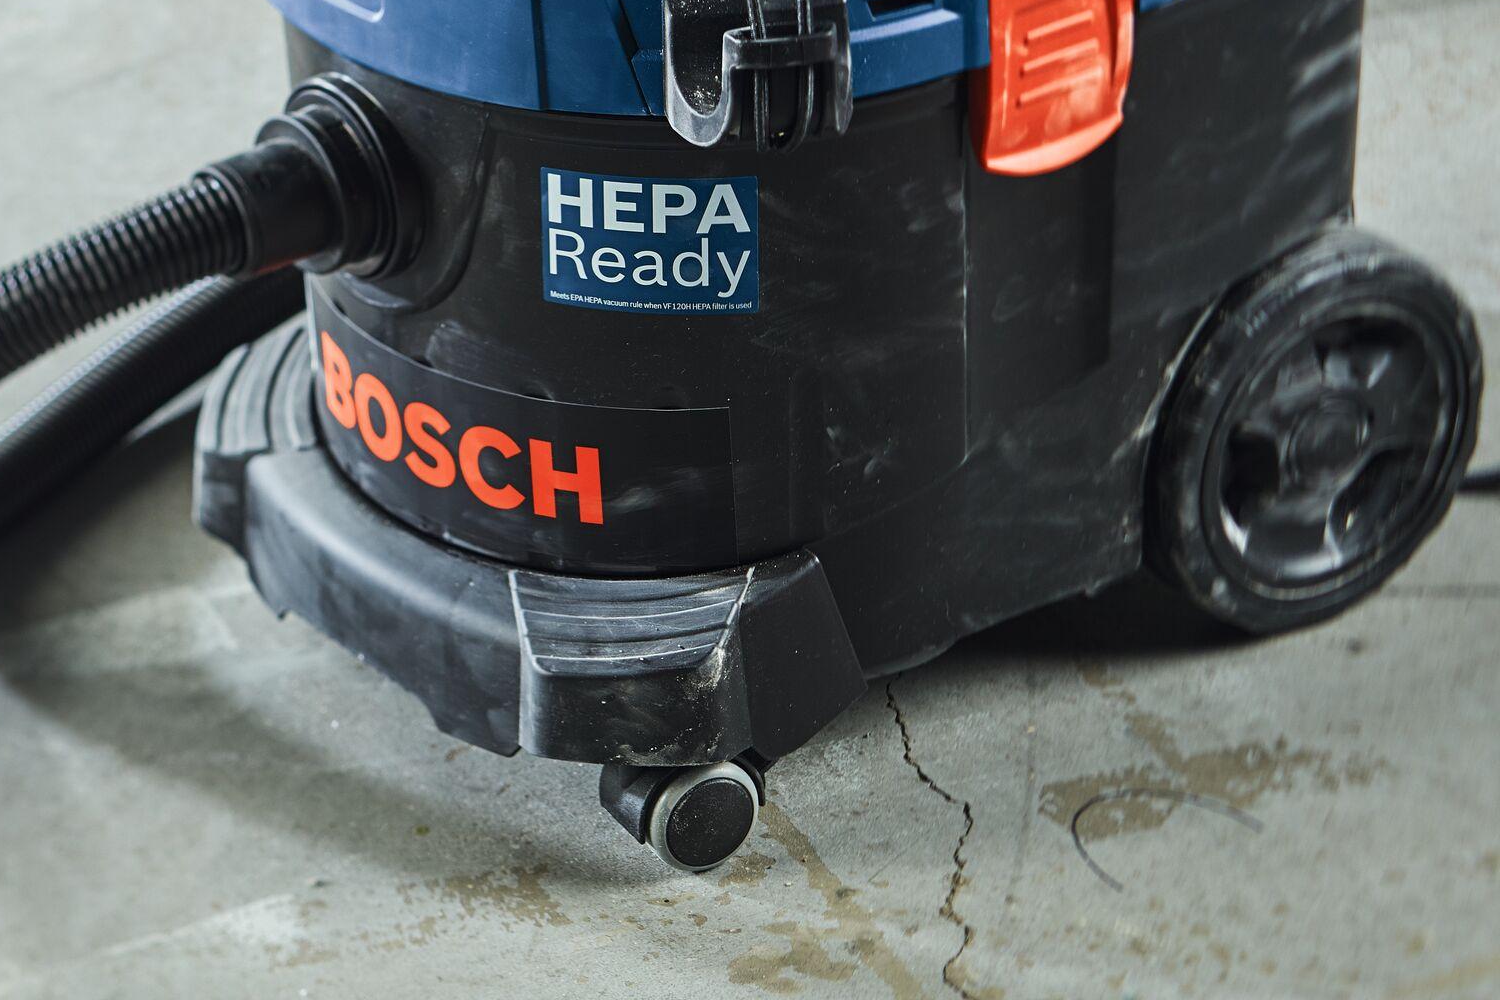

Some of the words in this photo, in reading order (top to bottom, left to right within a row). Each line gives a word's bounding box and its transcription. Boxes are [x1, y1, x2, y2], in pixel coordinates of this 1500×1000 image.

[548, 172, 750, 234] HEPA
[549, 228, 750, 298] Ready
[550, 290, 570, 301] Meets
[571, 293, 583, 302] EPA
[584, 295, 602, 305] HEPA
[603, 299, 629, 308] vacuum
[630, 300, 643, 308] rule
[644, 301, 662, 309] when
[692, 302, 711, 310] HEPA
[712, 301, 727, 310] filter
[728, 301, 734, 309] is
[735, 301, 752, 309] used
[321, 330, 604, 525] BOSCH
